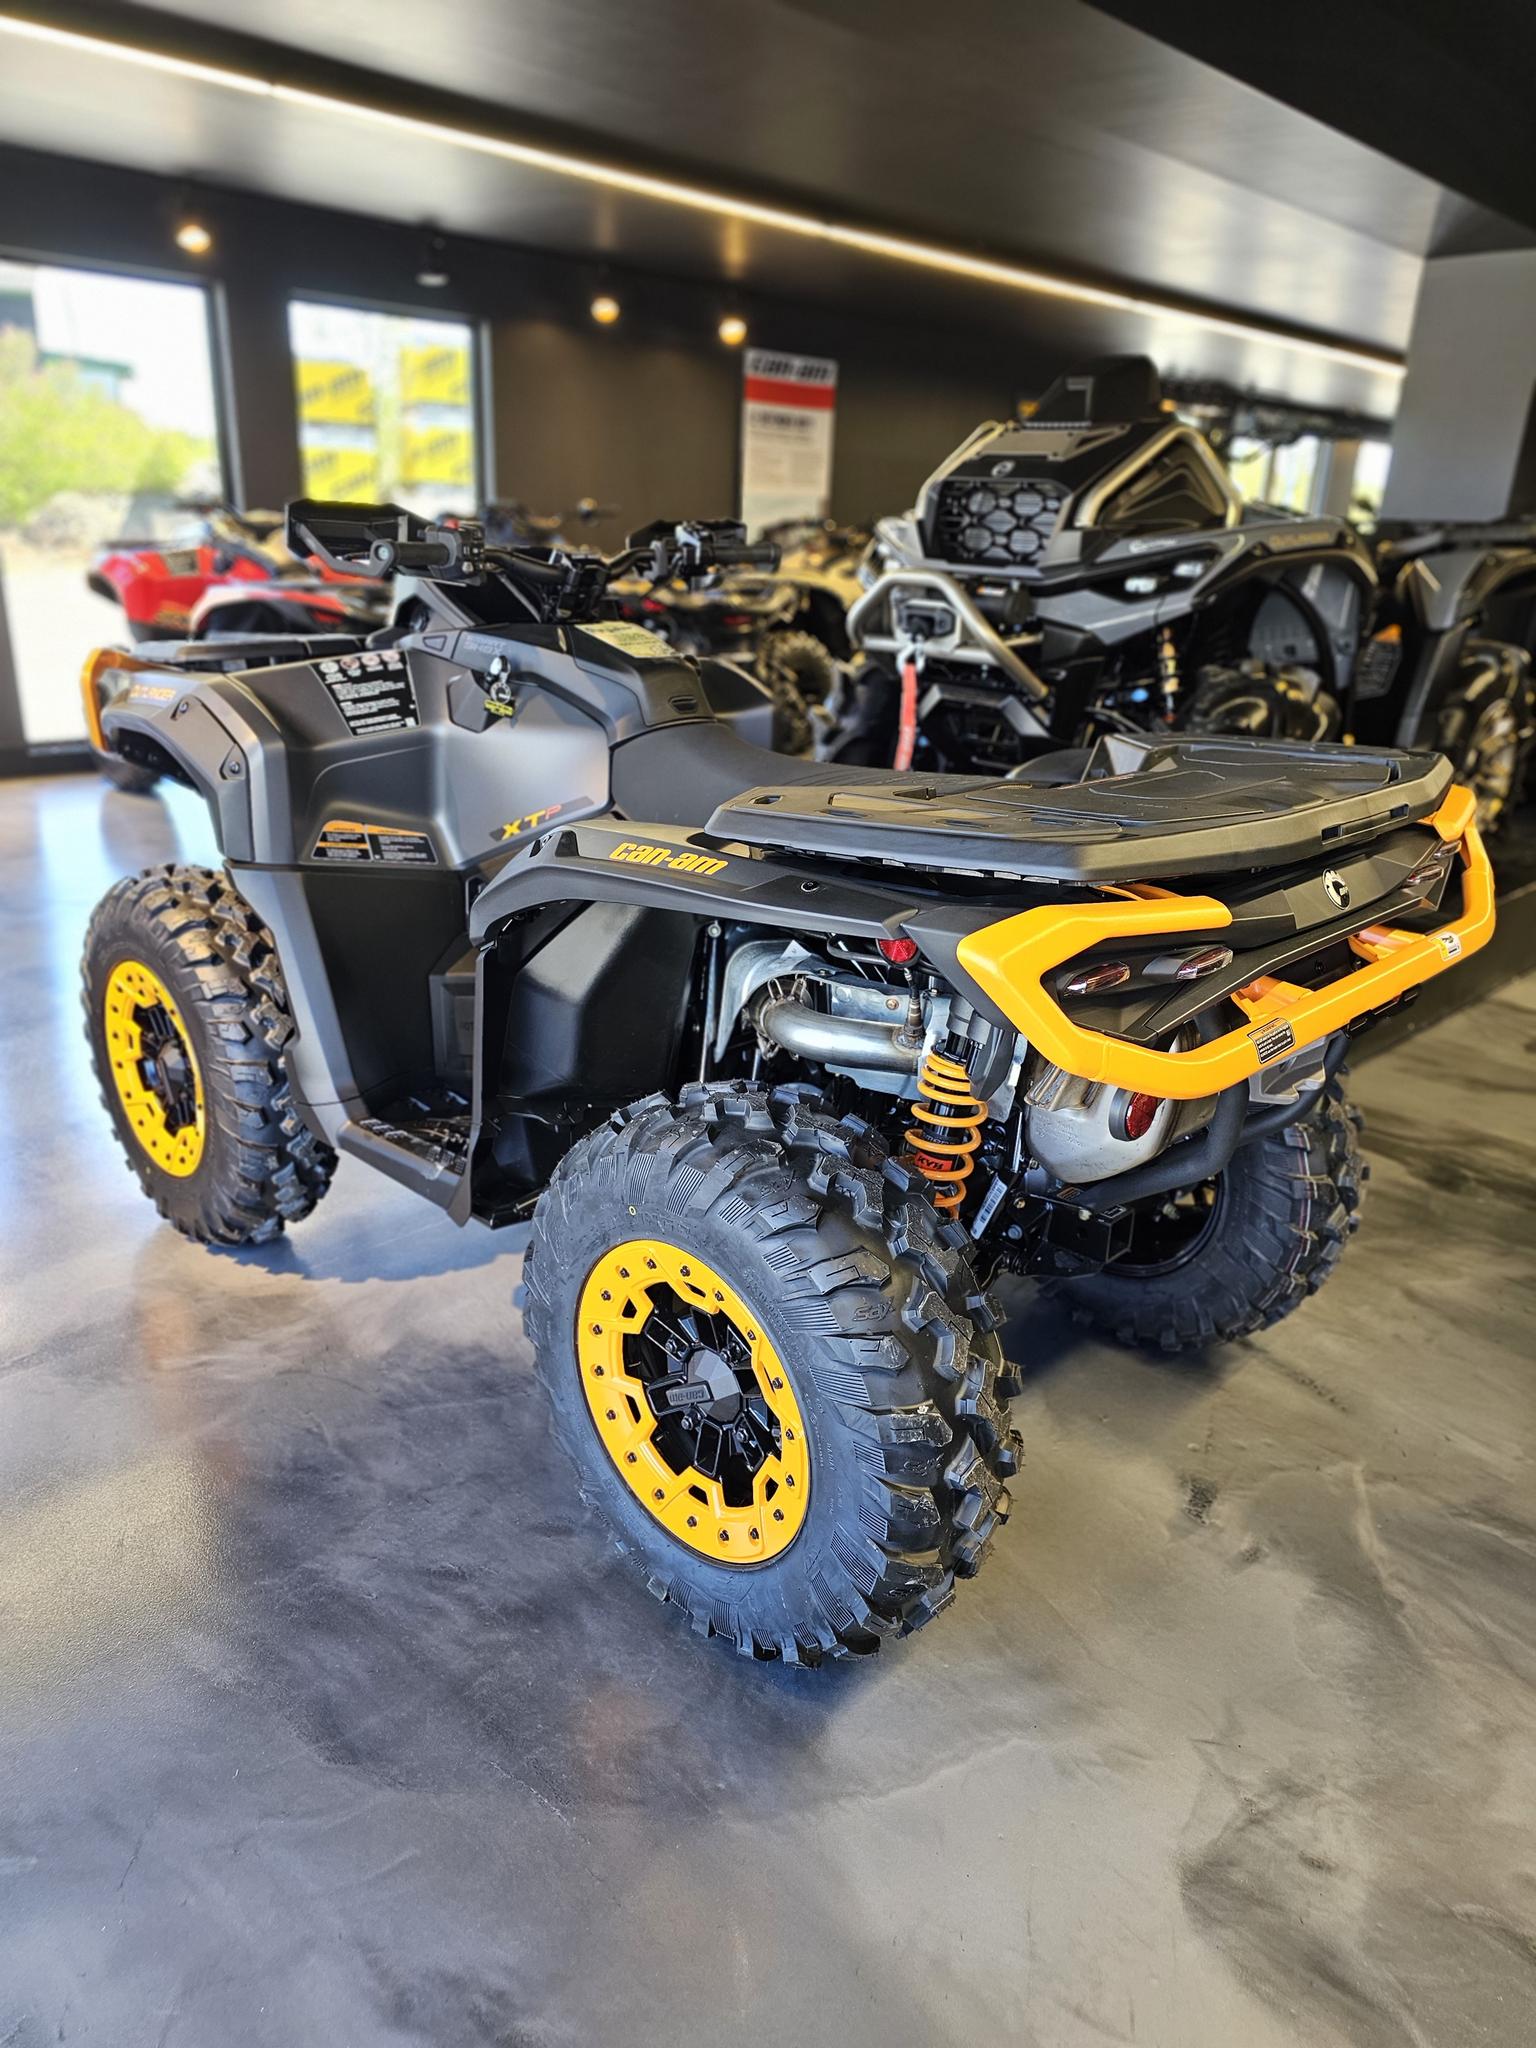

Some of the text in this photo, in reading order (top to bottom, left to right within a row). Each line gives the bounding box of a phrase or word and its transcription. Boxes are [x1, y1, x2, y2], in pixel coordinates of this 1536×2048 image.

[501, 803, 563, 841] XTP
[608, 840, 729, 876] can-am
[669, 1389, 706, 1403] can-am
